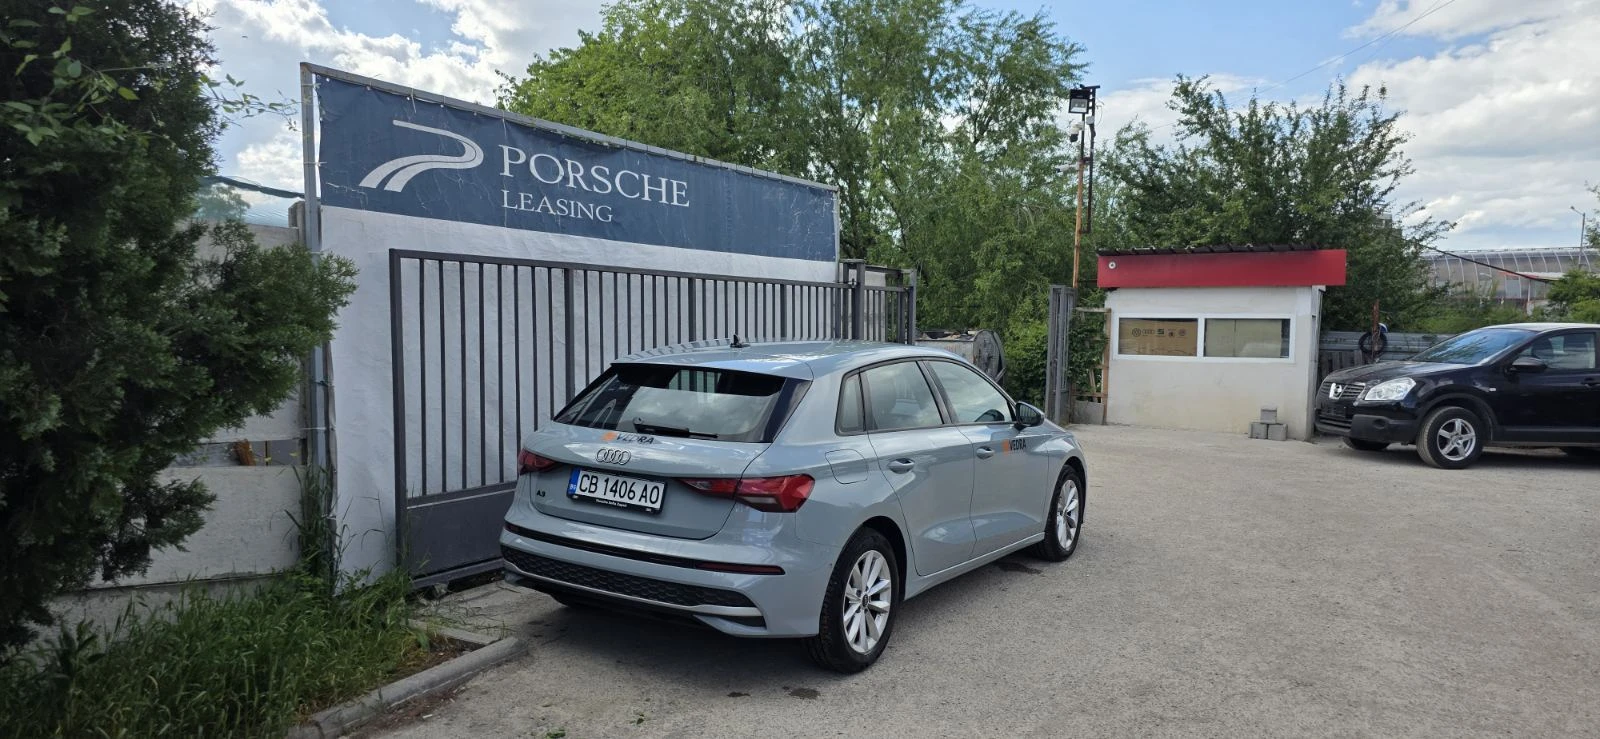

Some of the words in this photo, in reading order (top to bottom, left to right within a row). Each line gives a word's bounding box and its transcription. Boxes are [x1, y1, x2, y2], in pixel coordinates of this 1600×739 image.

[498, 144, 690, 207] PORSCHE
[501, 190, 613, 223] LEASING
[1009, 438, 1026, 450] VEDRA
[536, 490, 546, 498] A3
[579, 474, 599, 493] CB
[603, 477, 636, 500] 1406
